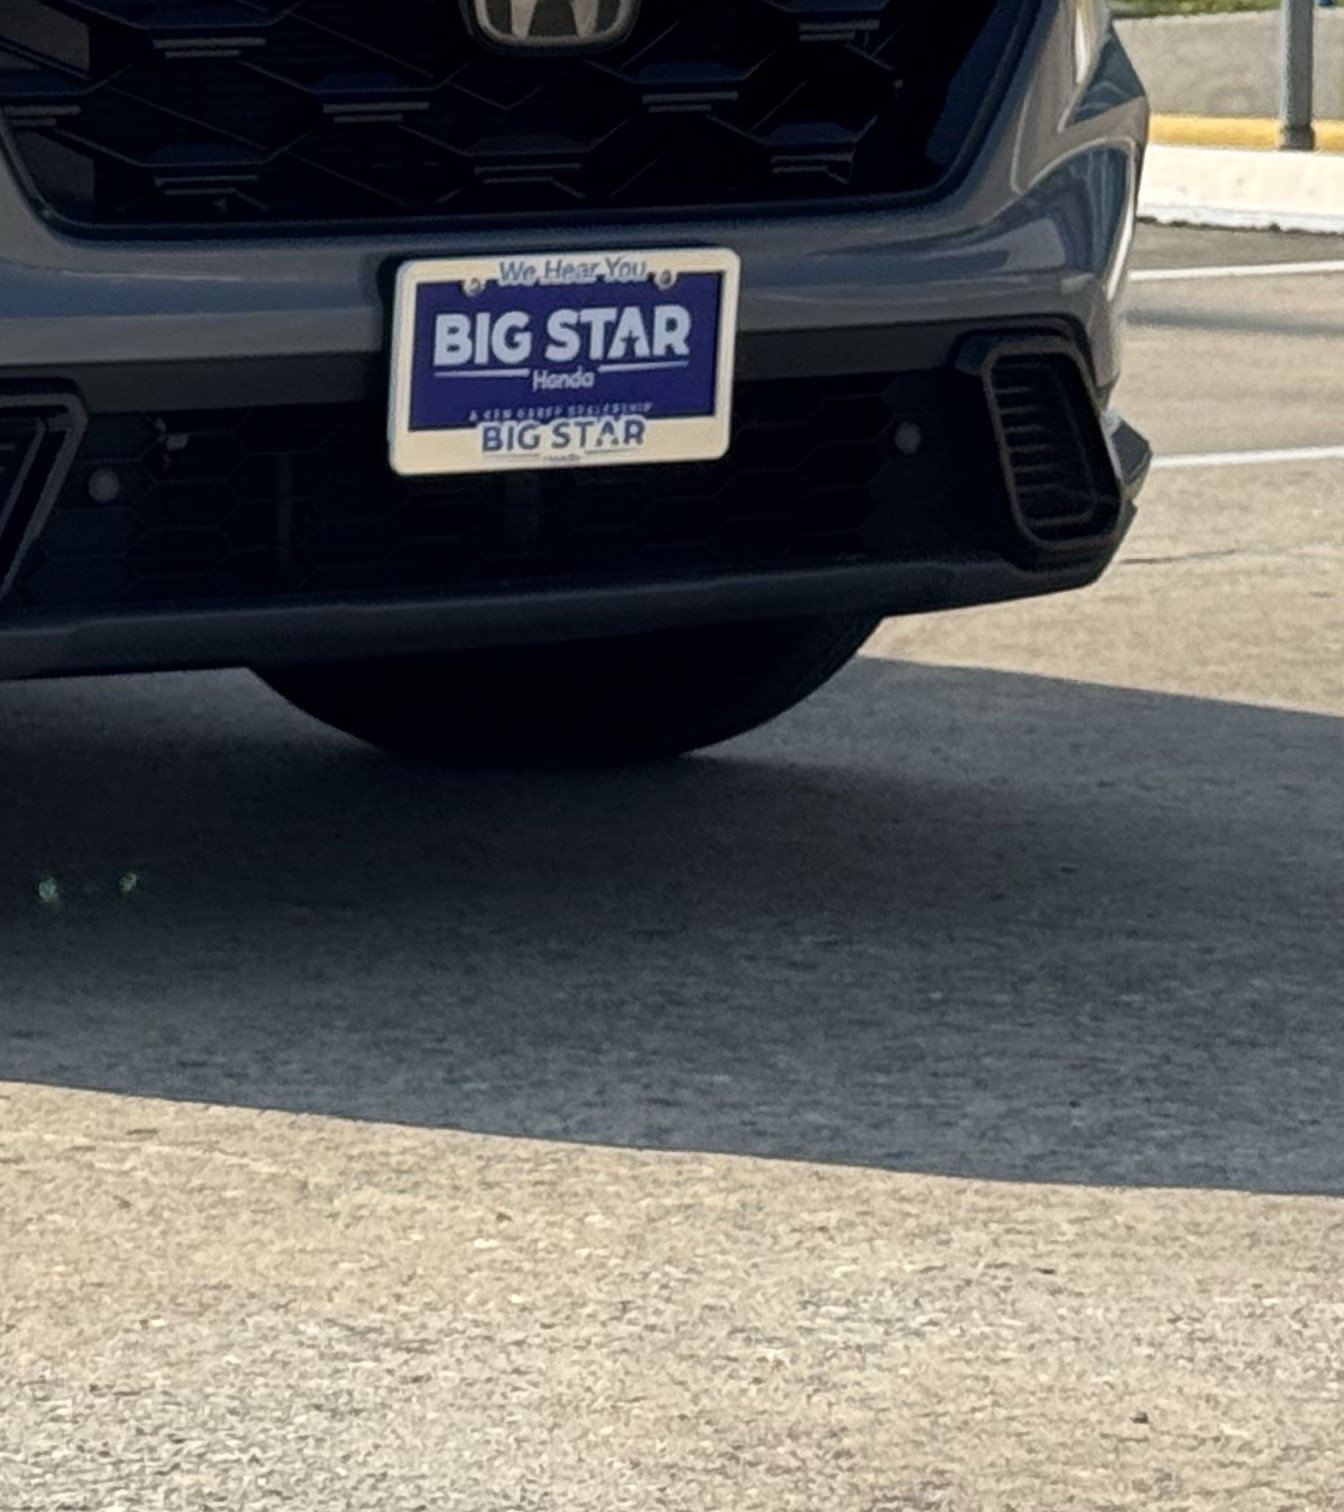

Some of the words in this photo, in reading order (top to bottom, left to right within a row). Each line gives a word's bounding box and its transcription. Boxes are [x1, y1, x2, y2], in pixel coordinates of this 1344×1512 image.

[498, 261, 536, 284] We
[544, 259, 599, 282] Hear
[604, 256, 647, 280] You
[433, 311, 532, 367] BIG
[544, 304, 691, 363] STAR
[533, 365, 595, 392] Honda
[481, 421, 541, 453] BIG
[550, 418, 646, 449] STAR
